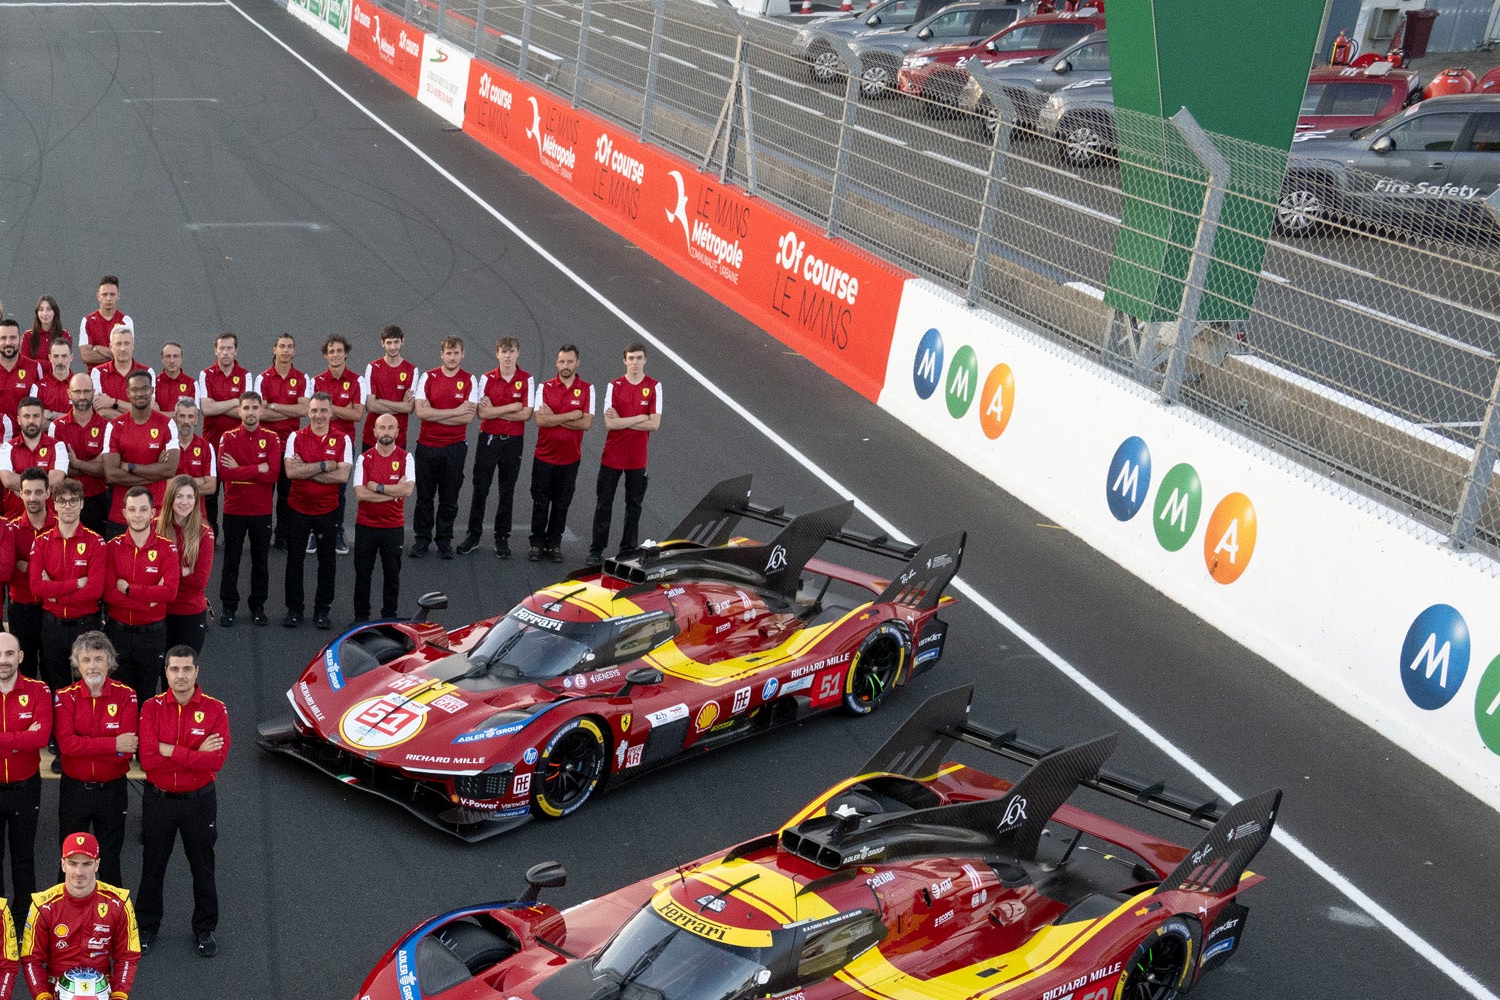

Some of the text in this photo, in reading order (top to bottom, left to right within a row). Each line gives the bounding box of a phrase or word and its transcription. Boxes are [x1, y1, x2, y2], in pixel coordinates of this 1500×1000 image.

[489, 83, 513, 111] course
[542, 133, 576, 169] Métropole
[611, 150, 645, 185] course
[608, 174, 641, 220] MANS
[1374, 180, 1481, 200] Fire Safety
[696, 184, 751, 239] LE MANS
[691, 219, 743, 269] Métropole
[803, 254, 859, 305] course
[772, 270, 853, 350] LE MANS
[513, 608, 564, 632] Ferrari
[594, 669, 621, 683] GENESYS
[790, 652, 850, 679] RICHARD MILLE
[819, 672, 842, 699] 51
[300, 681, 326, 722] RICHARD MILLE
[434, 698, 459, 712] CAR
[361, 702, 411, 734] 51
[457, 723, 525, 743] ADLER GROUP
[405, 753, 486, 764] RICHARD MILLE
[525, 749, 538, 764] hp
[460, 797, 498, 809] V-Power
[843, 853, 861, 864] ADLER
[657, 900, 728, 941] Ferrari
[398, 949, 409, 977] ADLER
[1090, 961, 1121, 982] MILLE
